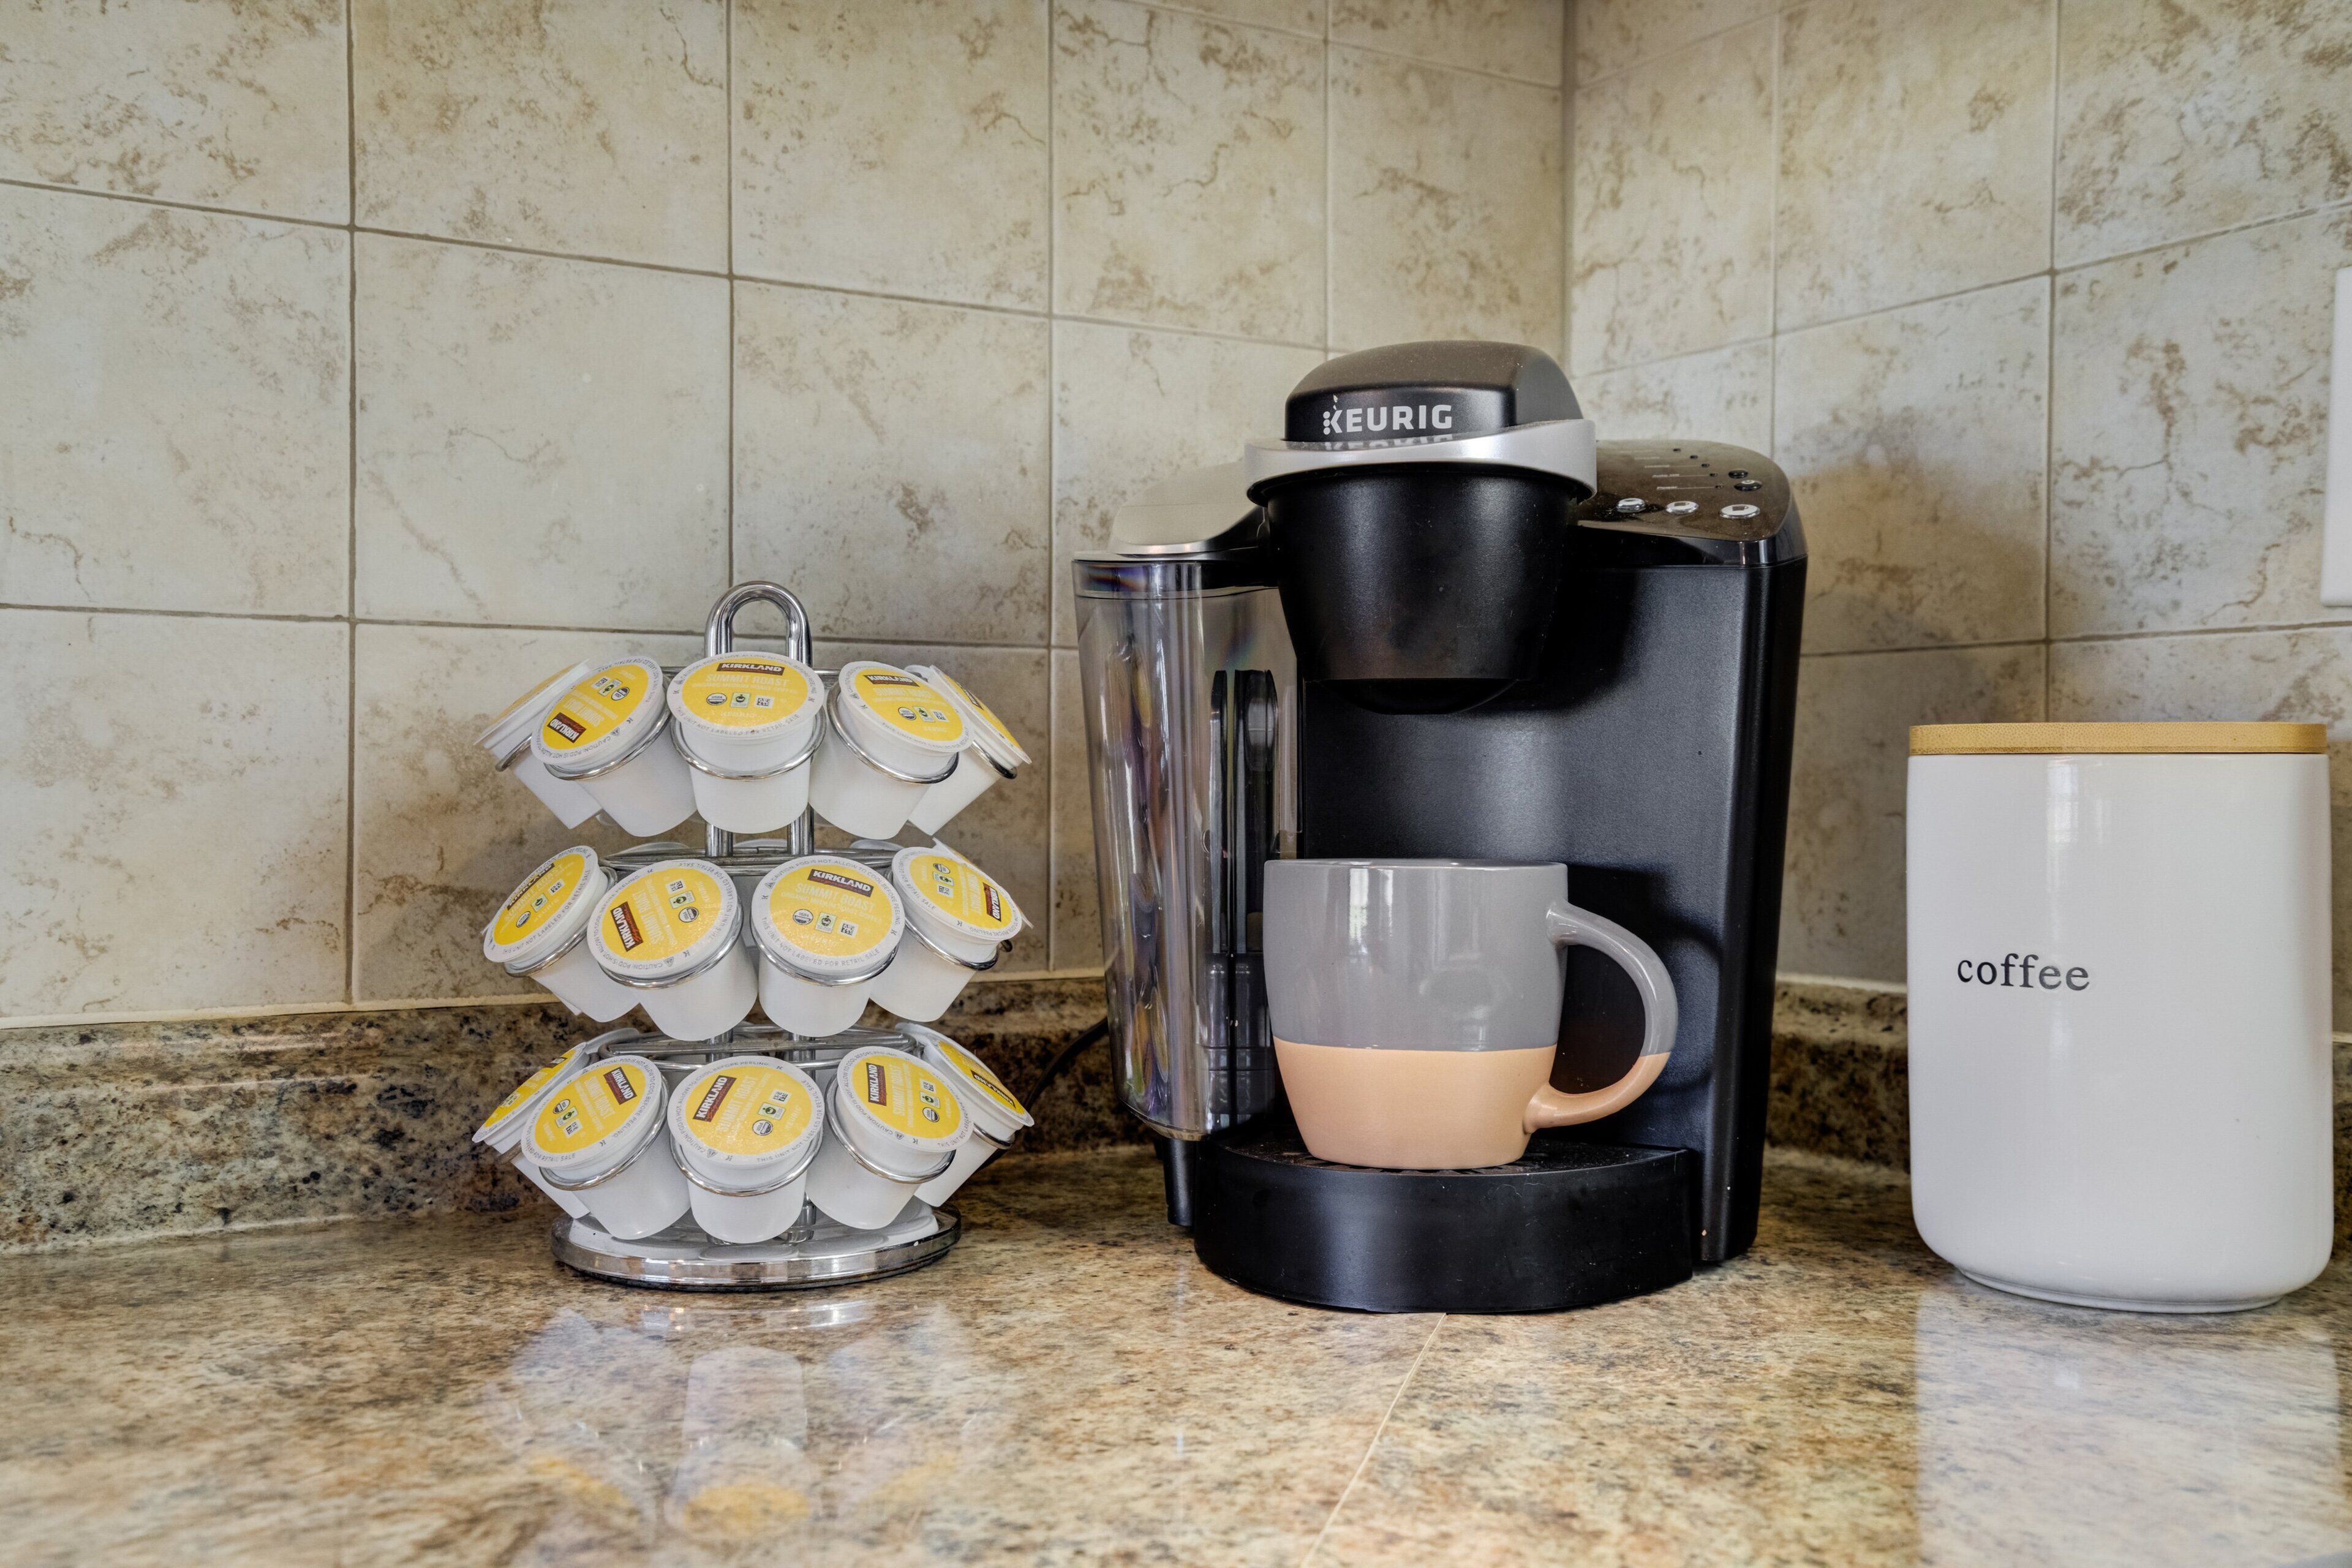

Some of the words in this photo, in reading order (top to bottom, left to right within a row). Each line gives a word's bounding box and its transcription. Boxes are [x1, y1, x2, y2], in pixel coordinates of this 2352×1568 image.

[1323, 404, 1452, 435] KEURIG
[722, 663, 782, 672] KIRKLAND
[549, 718, 579, 741] KIRKLAND
[696, 864, 715, 873] RETAIL
[715, 871, 725, 880] FOR
[834, 861, 858, 870] ALLOW
[866, 872, 884, 884] COOL
[722, 878, 734, 901] LABELED
[796, 882, 840, 902] SUMMIT
[813, 870, 872, 892] KIRKLAND
[990, 888, 1000, 920] KIRKLAND
[612, 907, 636, 949] KIRKLAND
[641, 910, 665, 945] SUMMIT
[864, 949, 881, 960] SALE
[1958, 953, 2089, 990] coffee
[611, 1068, 635, 1101] KIRKLAND
[802, 1080, 815, 1091] SALE
[869, 1064, 880, 1102] KIRKLAND
[677, 1087, 692, 1104] ALLOW
[696, 1076, 729, 1118] KIRKLAND
[812, 1092, 822, 1108] RETAIL
[677, 1123, 687, 1134] POD
